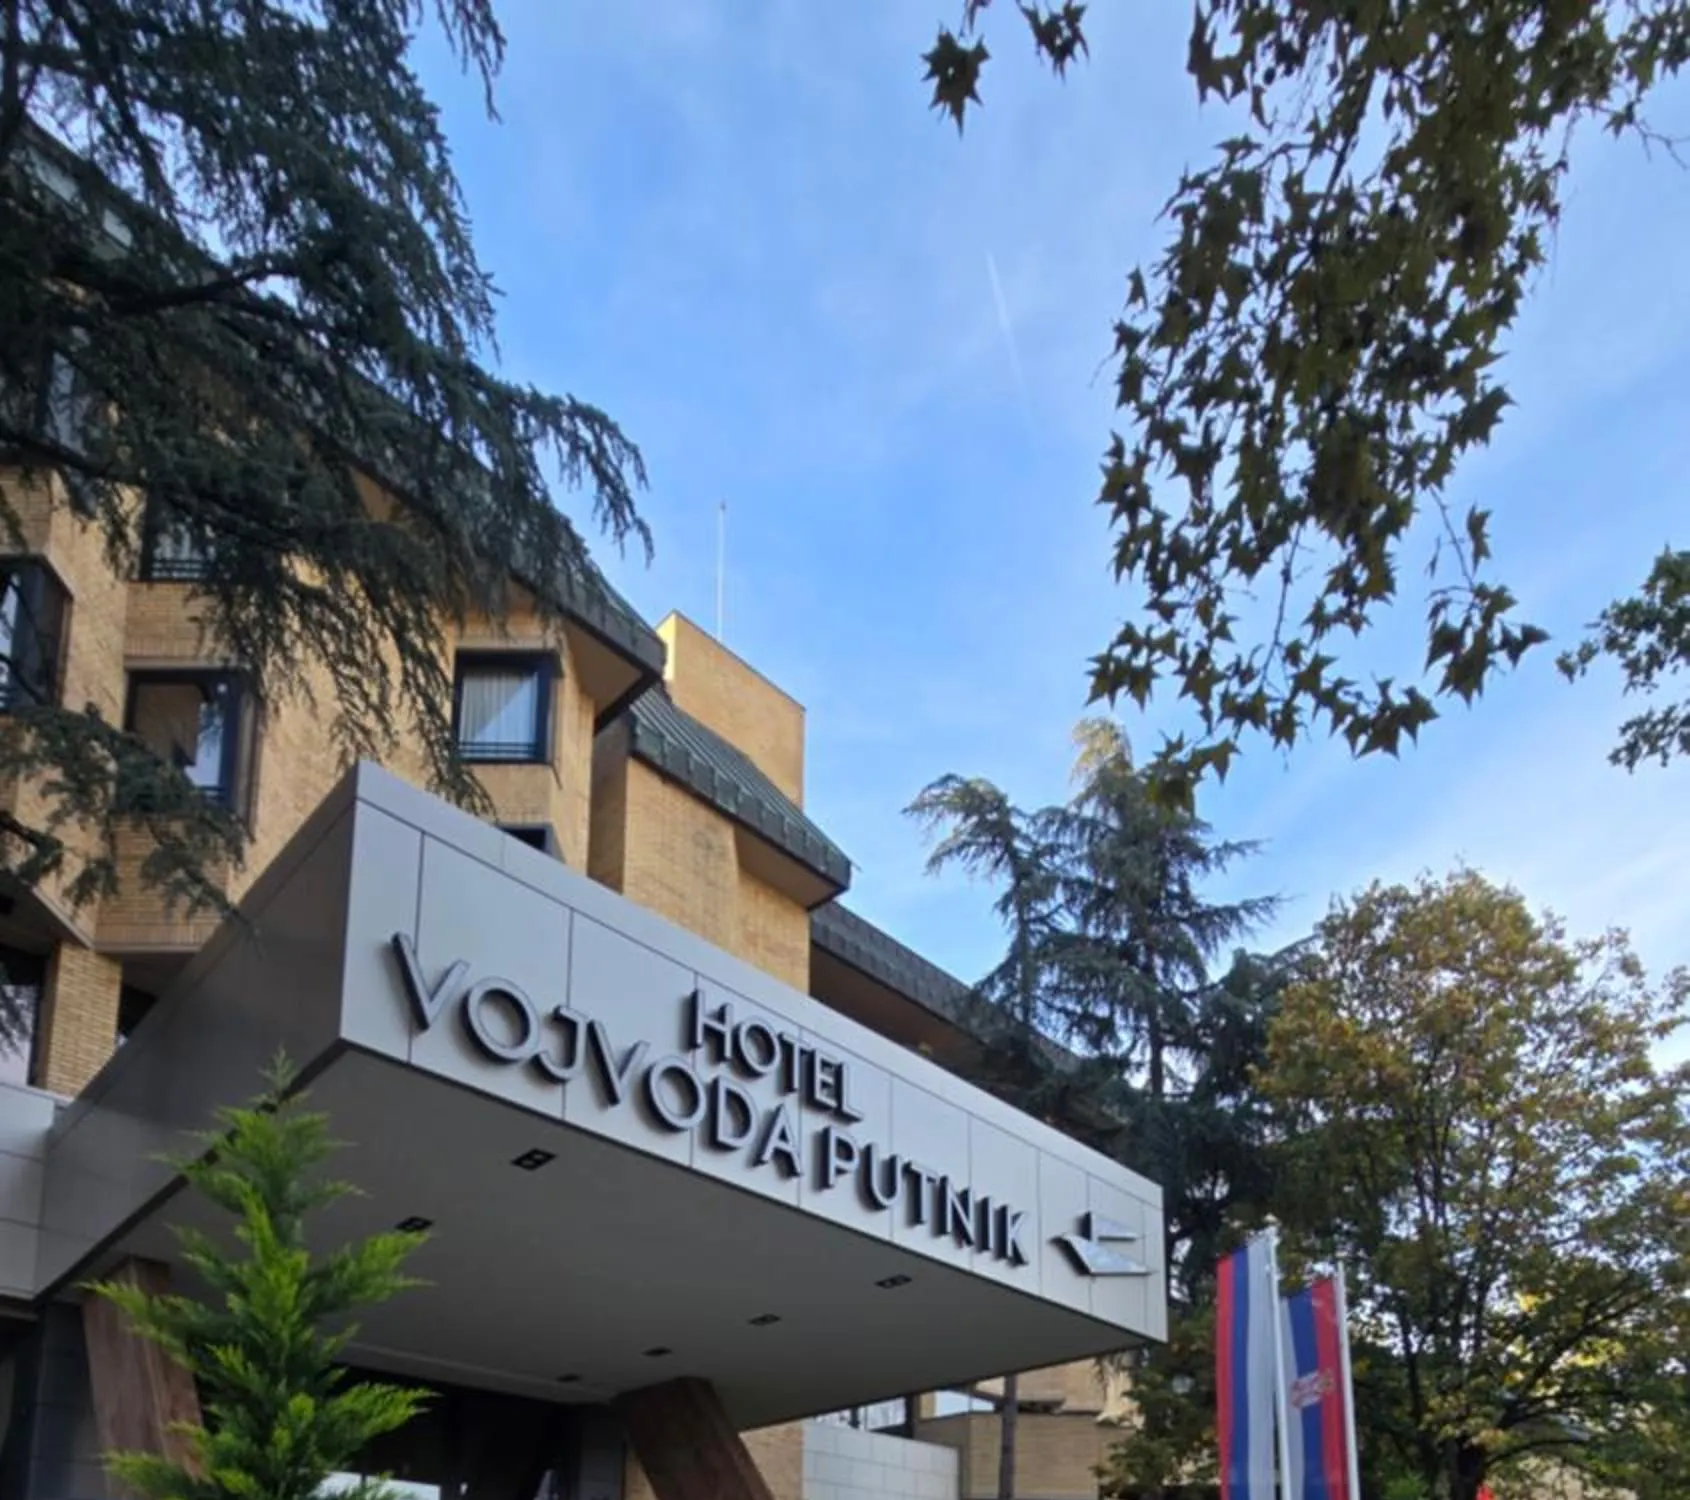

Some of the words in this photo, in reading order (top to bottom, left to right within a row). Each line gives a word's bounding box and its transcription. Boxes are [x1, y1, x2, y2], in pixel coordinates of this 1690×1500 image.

[391, 932, 801, 1178] VOJVODA
[820, 1126, 1030, 1266] PUTNIK
[685, 988, 863, 1123] HOTEL
